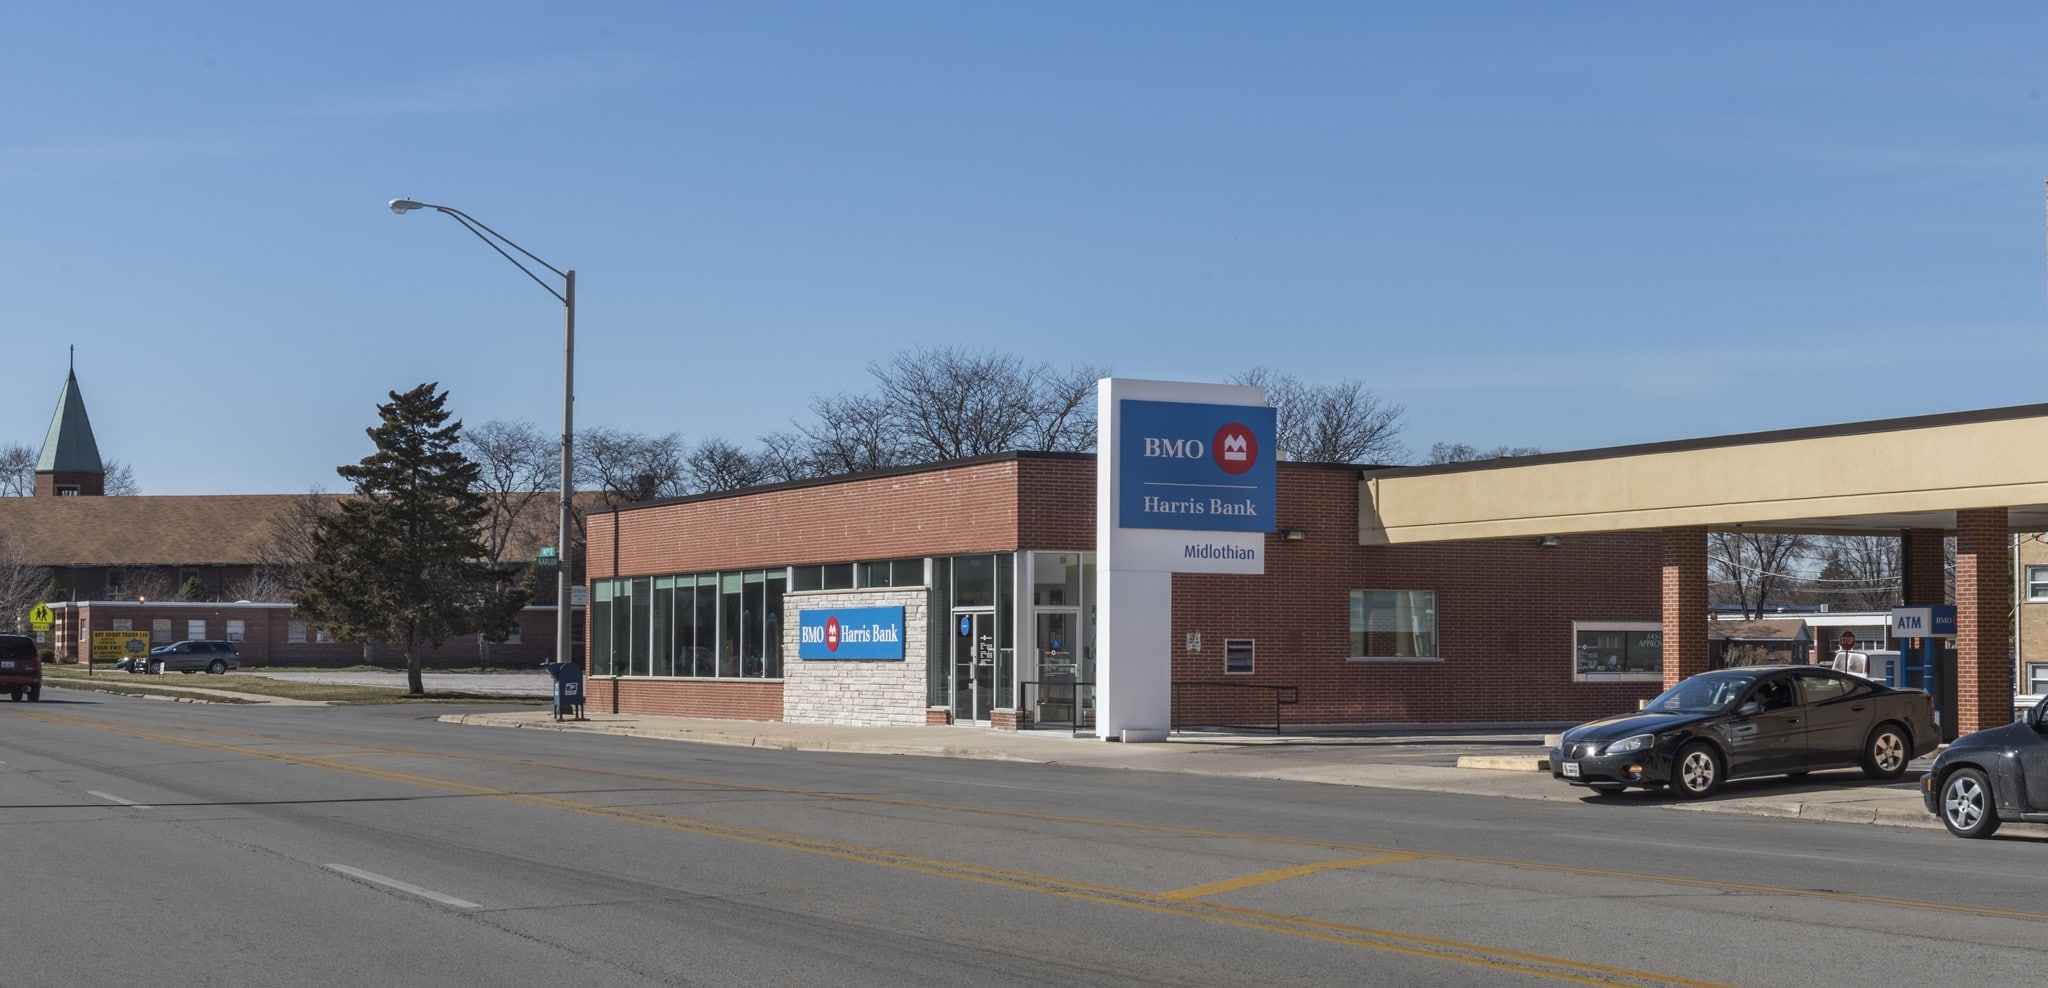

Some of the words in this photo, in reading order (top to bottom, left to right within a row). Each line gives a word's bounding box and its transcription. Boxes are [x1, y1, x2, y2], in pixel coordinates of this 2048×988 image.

[1144, 437, 1204, 459] BMO
[1143, 496, 1204, 515] Harris
[1209, 498, 1257, 516] Bank
[1184, 543, 1255, 561] Midlothian
[1897, 616, 1922, 629] ATM
[802, 625, 824, 644] BMO
[841, 625, 871, 643] Harris
[872, 623, 898, 642] Bank
[1840, 636, 1855, 645] STOP
